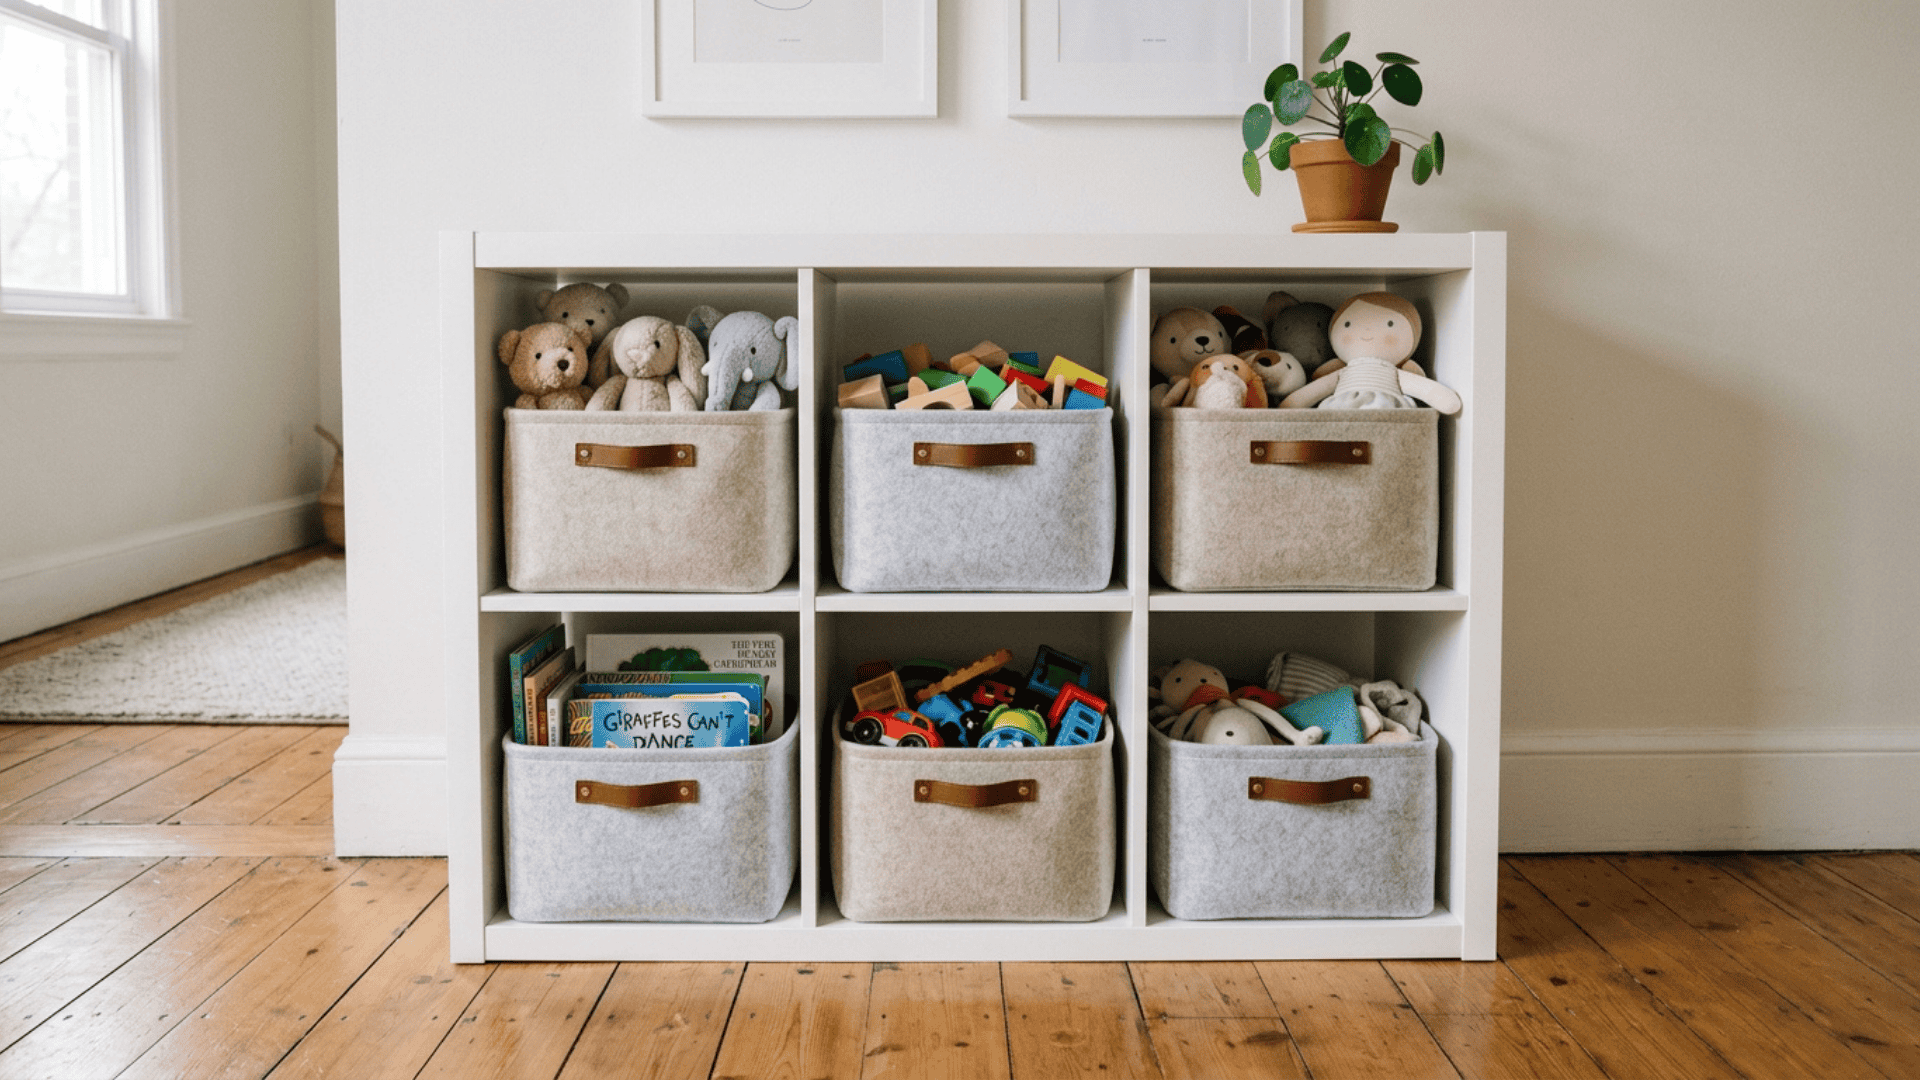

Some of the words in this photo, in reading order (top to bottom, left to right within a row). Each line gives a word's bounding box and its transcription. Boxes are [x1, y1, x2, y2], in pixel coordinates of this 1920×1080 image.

[603, 709, 682, 731] GIRAFFES
[687, 711, 735, 731] CAN'T
[633, 733, 695, 748] DANCE
